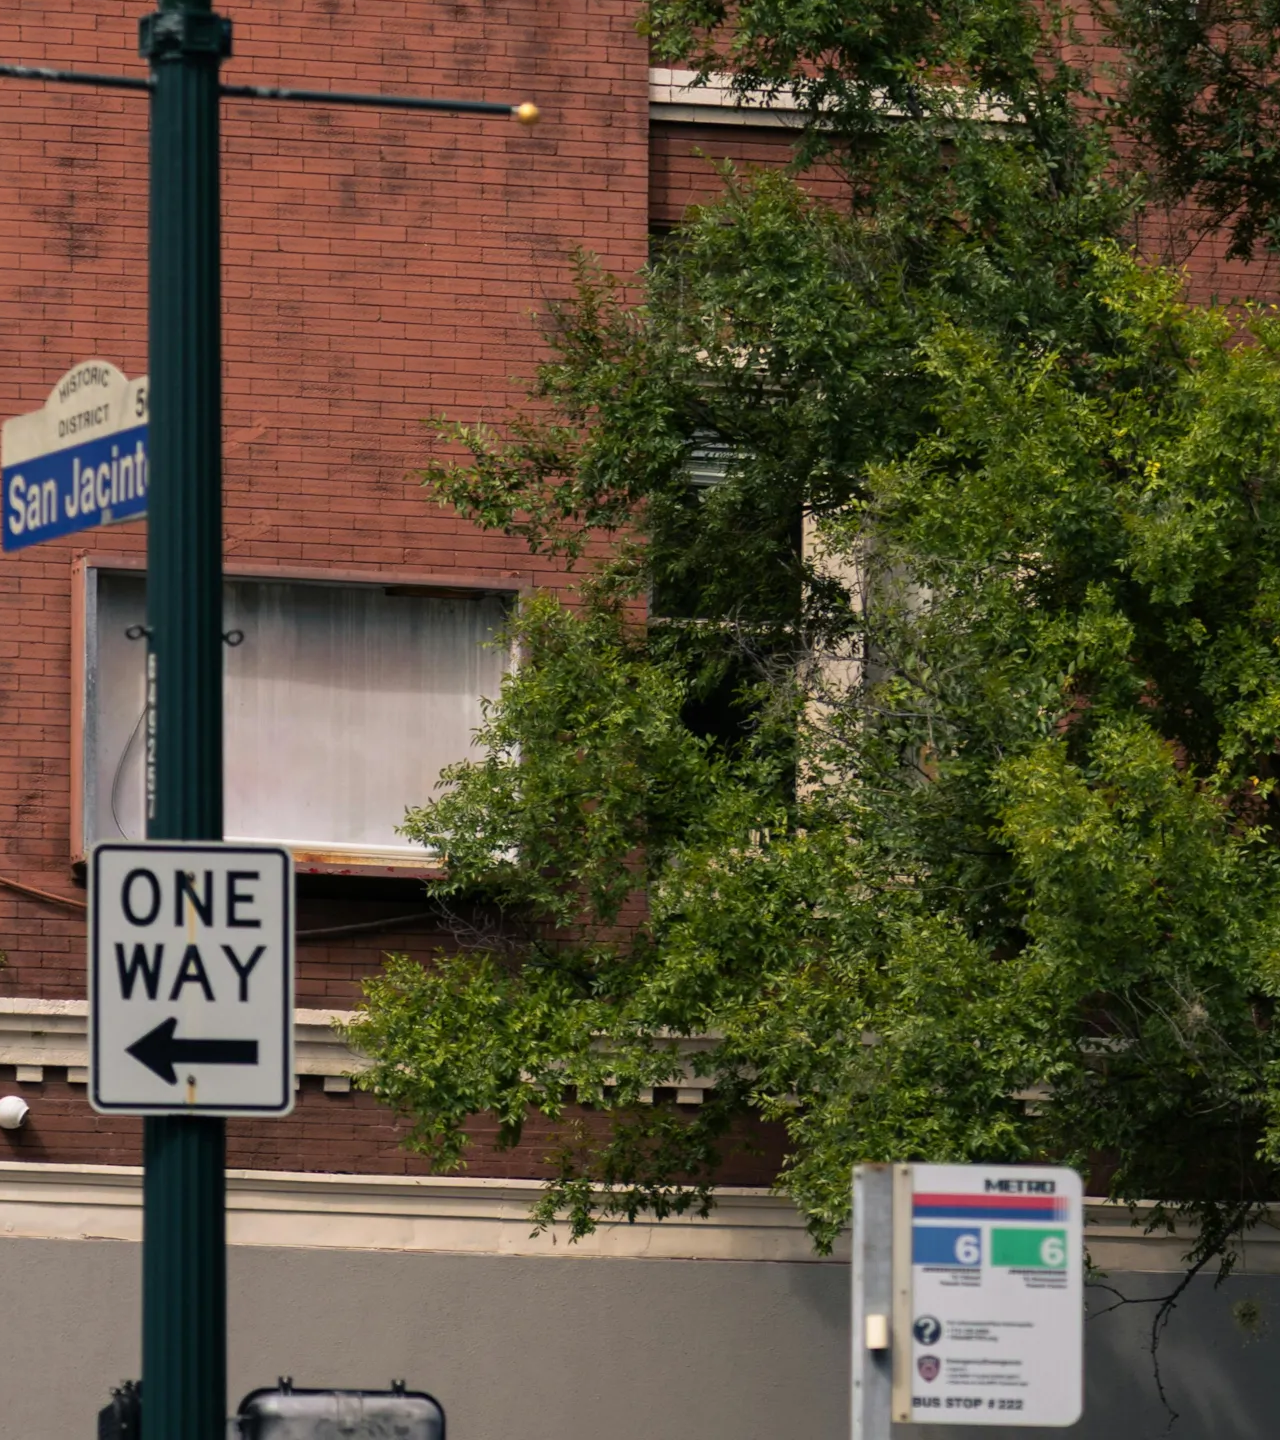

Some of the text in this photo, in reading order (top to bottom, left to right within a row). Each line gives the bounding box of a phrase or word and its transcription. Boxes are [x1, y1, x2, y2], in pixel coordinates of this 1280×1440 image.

[58, 365, 111, 403] HISTORIC
[58, 403, 111, 438] DISTRICT
[8, 474, 57, 536] San
[121, 868, 262, 929] ONE
[114, 942, 267, 1003] WAY
[984, 1178, 1057, 1194] METRO
[954, 1234, 980, 1265] 6
[1040, 1237, 1065, 1267] 6
[912, 1396, 941, 1409] BUS
[945, 1397, 982, 1410] STOP
